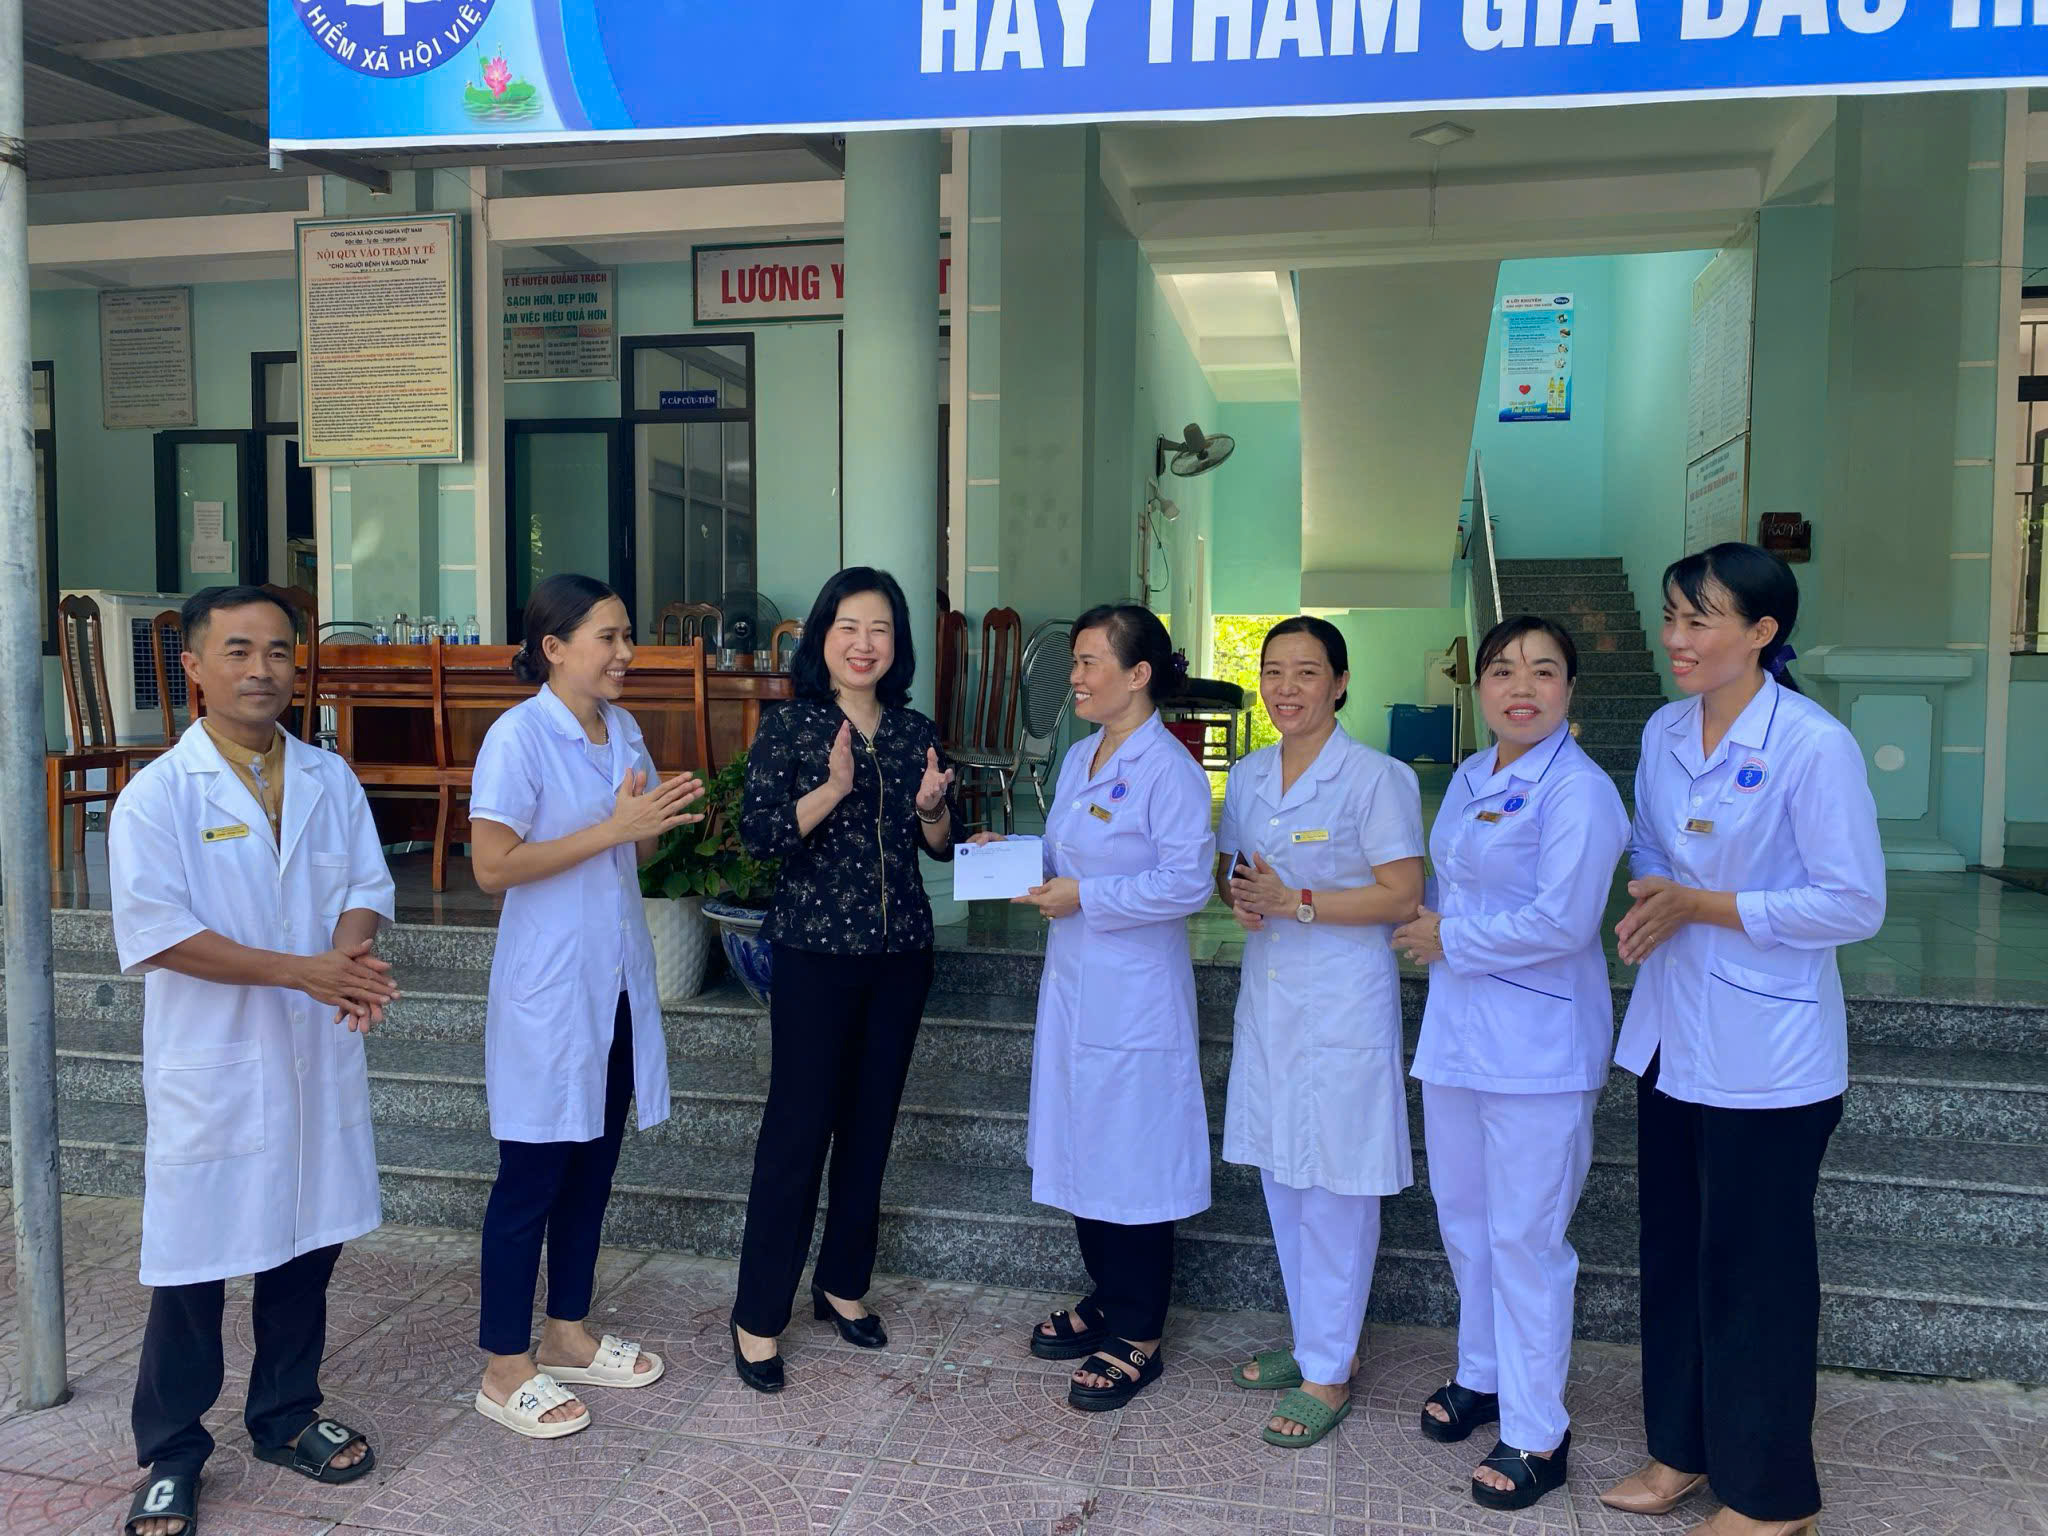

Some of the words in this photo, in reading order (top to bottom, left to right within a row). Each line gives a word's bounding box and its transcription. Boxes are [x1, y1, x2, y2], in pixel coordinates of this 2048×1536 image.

[307, 5, 357, 61] HIỂM
[361, 45, 389, 71] XÃ
[400, 37, 443, 70] HỘI
[444, 0, 489, 45] VIỆ
[316, 248, 335, 261] NỘI
[336, 249, 358, 260] QUY
[360, 246, 380, 258] VÀO
[382, 246, 411, 258] TRẠM
[413, 246, 421, 255] Y
[422, 242, 436, 254] TẾ
[365, 260, 381, 268] BỆNH
[511, 275, 520, 287] TẾ
[721, 264, 820, 304] LƯƠNG
[506, 295, 531, 308] SẠCH
[557, 294, 576, 307] ĐẸP
[578, 292, 598, 303] HƠN
[520, 311, 541, 325] VIỆC
[543, 309, 564, 324] HIỆU
[566, 307, 585, 321] QUẢ
[587, 309, 607, 320] HƠN
